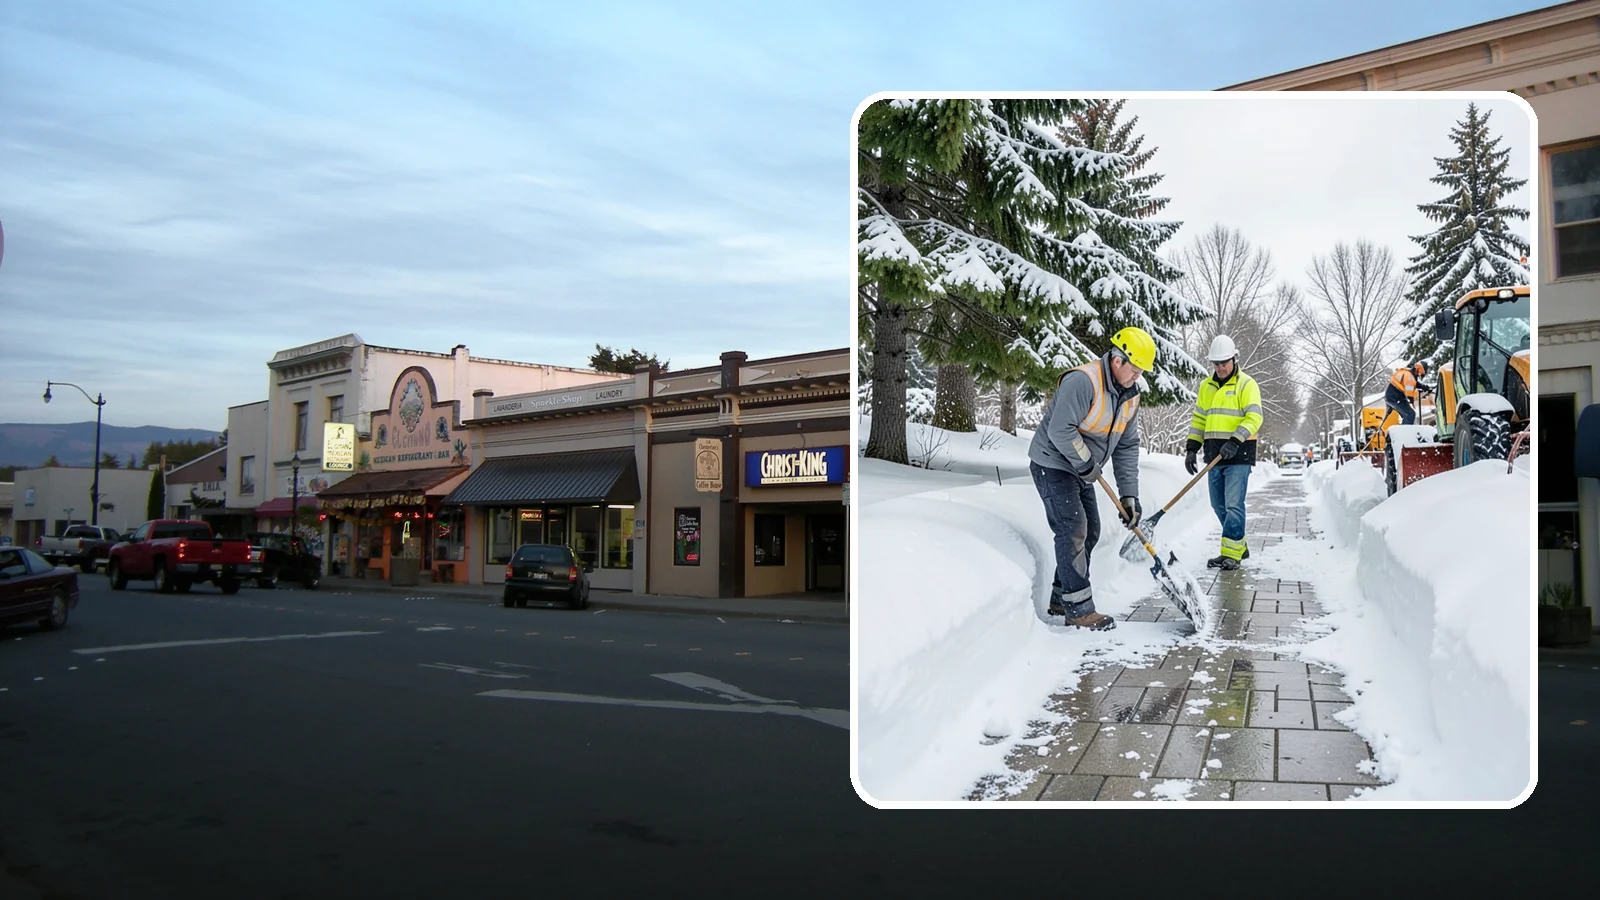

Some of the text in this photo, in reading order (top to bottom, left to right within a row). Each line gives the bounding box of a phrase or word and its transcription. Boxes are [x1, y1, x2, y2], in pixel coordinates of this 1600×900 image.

[493, 389, 624, 413] LAVANDERIA Sparkle Shop LAUNDRY
[373, 455, 396, 464] MEXICAN
[397, 452, 433, 462] RESTAURANT
[437, 450, 450, 459] BAR
[799, 450, 828, 477] KING
